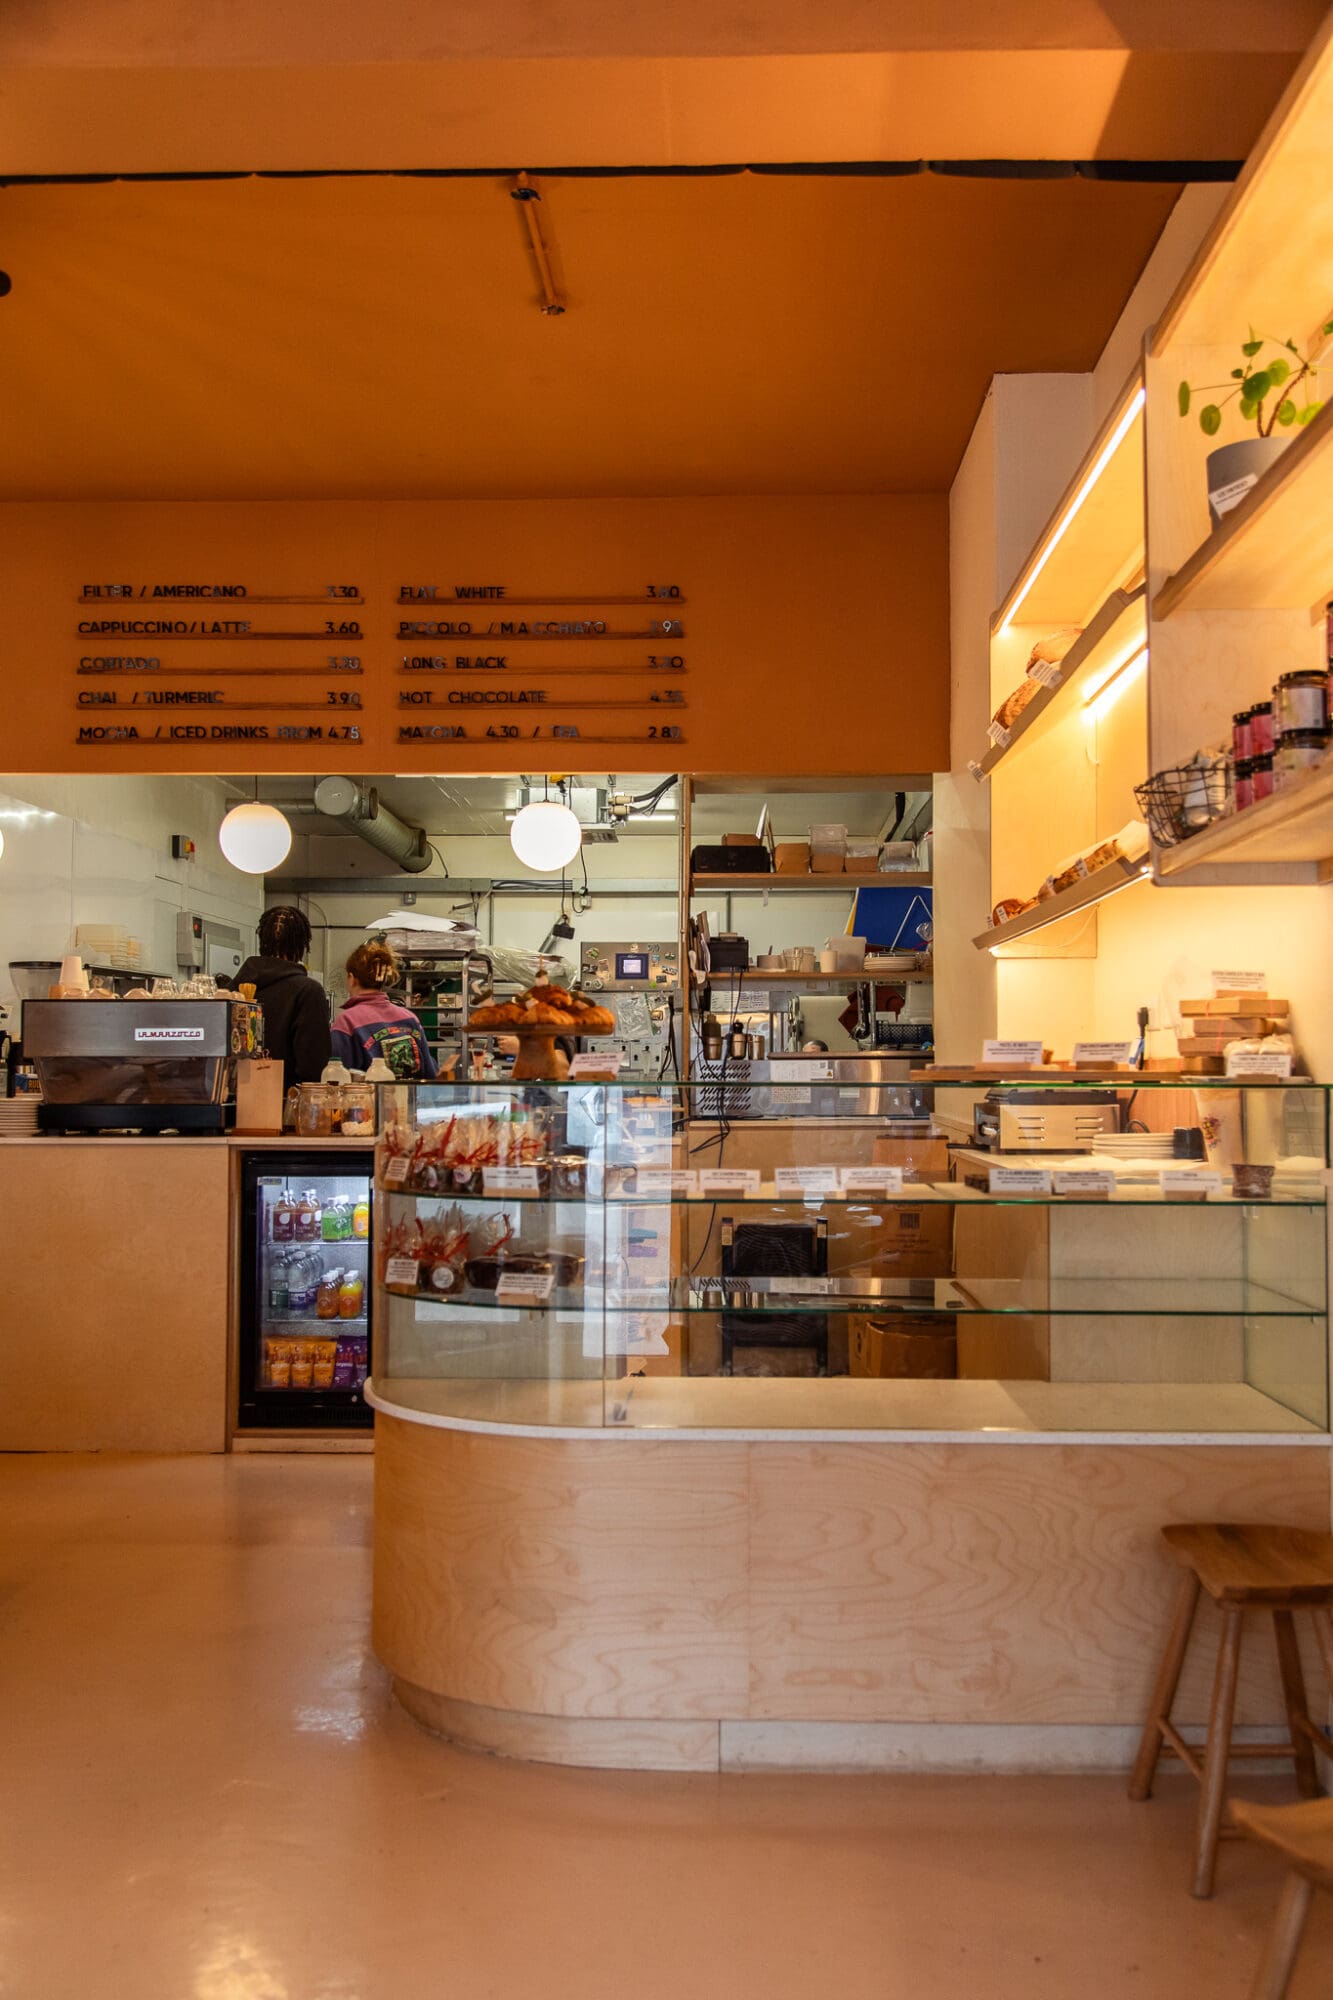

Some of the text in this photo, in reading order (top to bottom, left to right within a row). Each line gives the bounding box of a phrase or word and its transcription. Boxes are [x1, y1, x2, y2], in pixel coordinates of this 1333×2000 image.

[83, 586, 132, 597] FILTER
[152, 586, 247, 597] AMERICANO
[400, 586, 437, 598] FLAT
[456, 586, 505, 598] WHITE
[79, 622, 186, 633] CAPPUCCINO
[202, 622, 252, 633] LATTE
[326, 622, 359, 633] 3.60
[400, 622, 470, 634] PICCOLO
[80, 657, 160, 670] CORTADO
[403, 656, 446, 669] LONG
[456, 656, 506, 669] BLACK
[79, 692, 116, 704] CHAI
[145, 691, 224, 704] TURMERIC
[400, 692, 432, 703] HOT
[448, 691, 546, 703] CHOCOLATE
[80, 727, 138, 739] MOCHA
[170, 727, 207, 739] ICED
[212, 726, 268, 739] DRINKS
[277, 726, 322, 739] FROM
[329, 726, 359, 739] 4.75
[400, 726, 465, 738] MATCHA
[486, 726, 518, 738] 4.30
[551, 725, 579, 738] TEA
